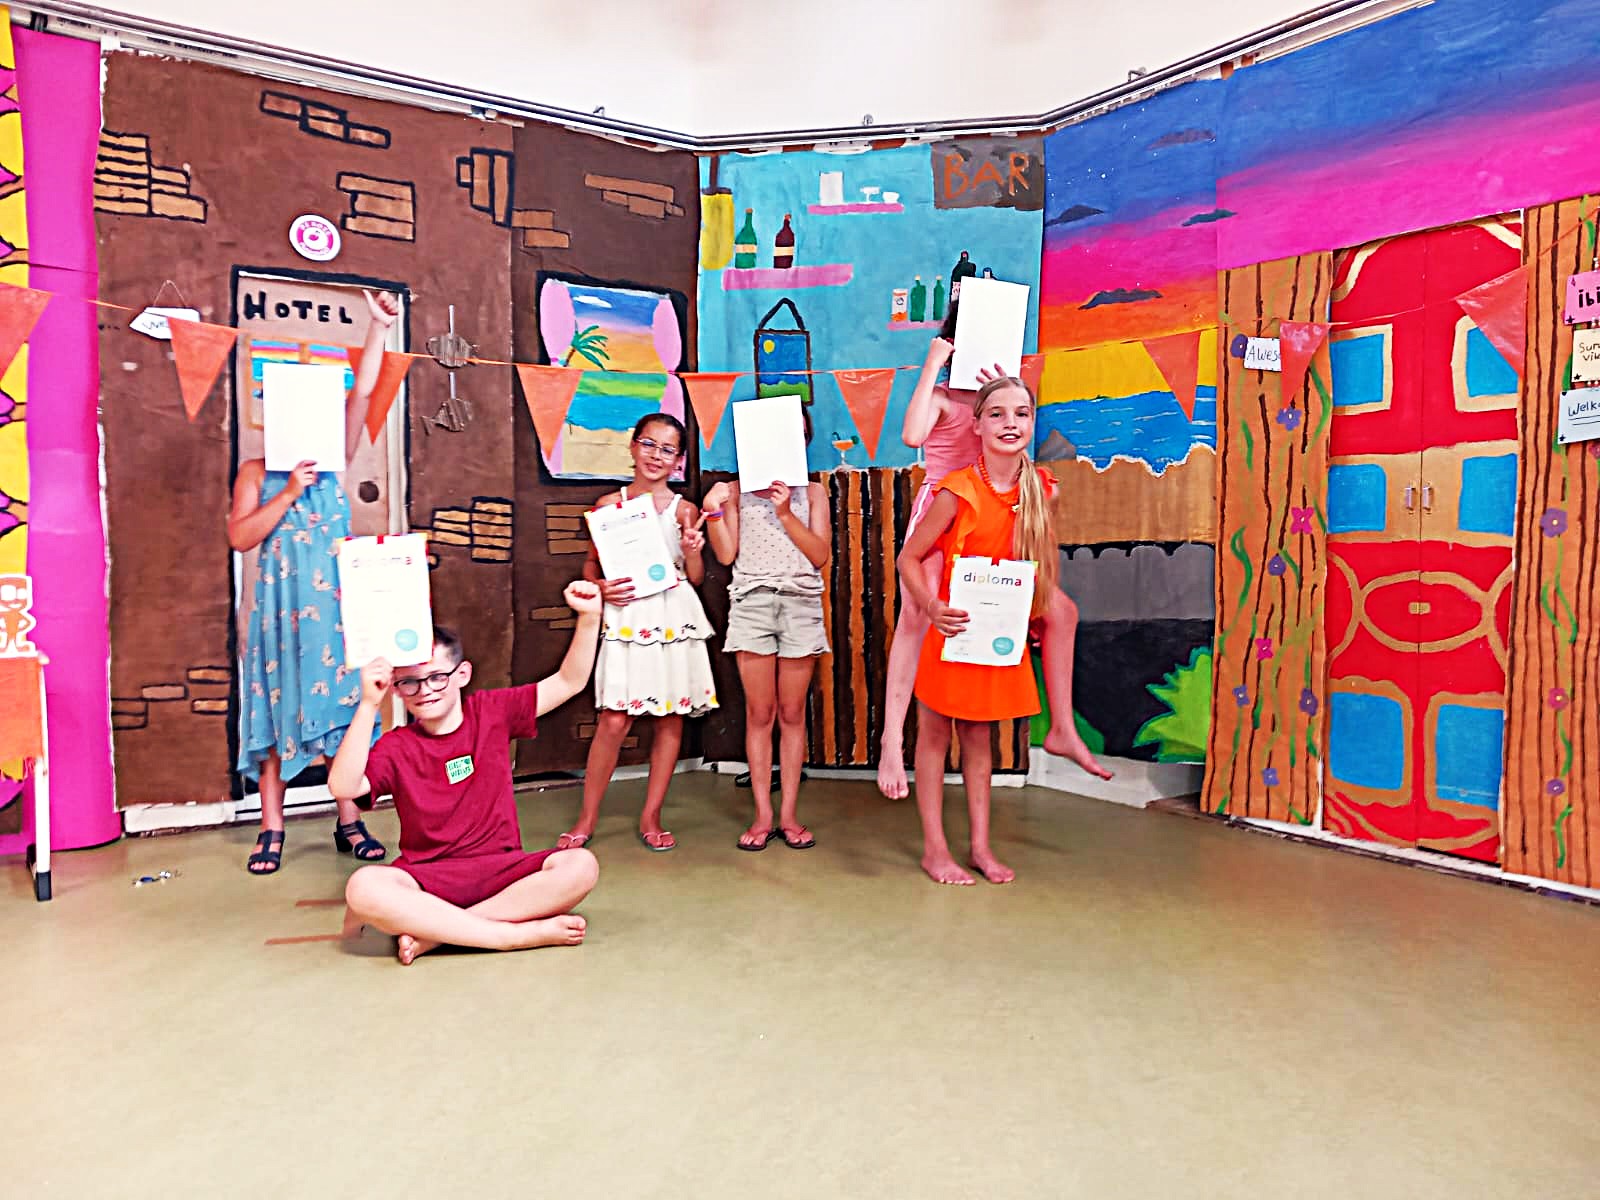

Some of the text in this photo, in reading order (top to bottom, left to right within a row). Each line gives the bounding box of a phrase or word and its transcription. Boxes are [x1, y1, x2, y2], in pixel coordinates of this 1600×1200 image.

[944, 151, 1030, 199] BAR
[243, 290, 353, 324] HOTEL
[1246, 345, 1281, 362] Awes
[963, 572, 1022, 587] diploma
